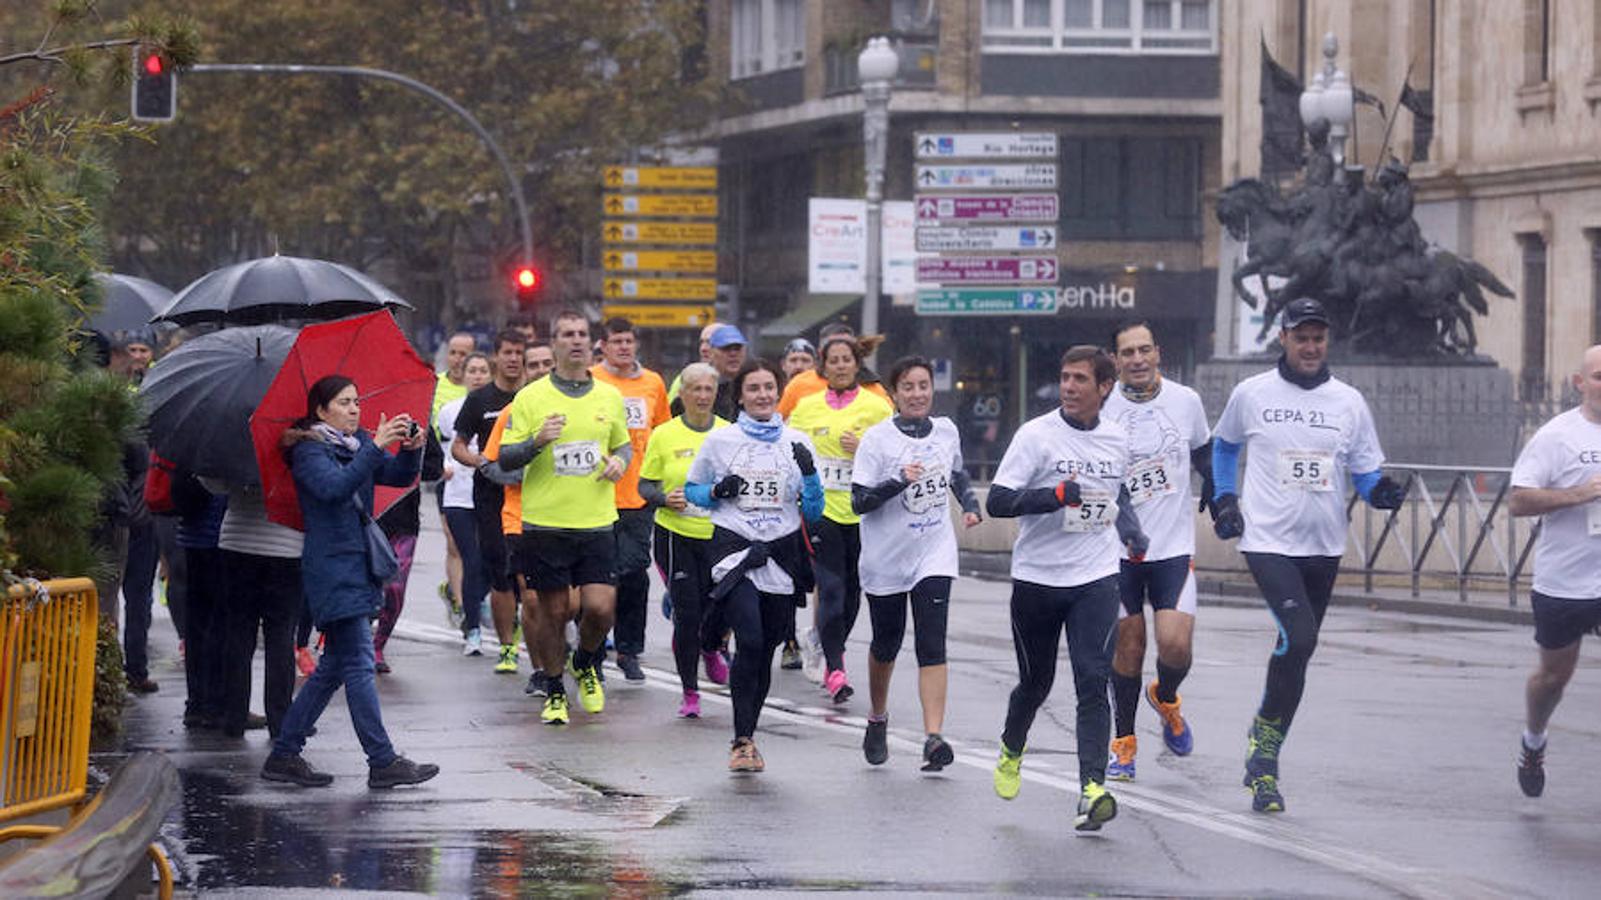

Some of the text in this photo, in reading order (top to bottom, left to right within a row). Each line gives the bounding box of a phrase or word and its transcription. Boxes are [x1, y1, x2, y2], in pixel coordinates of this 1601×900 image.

[813, 223, 864, 238] CreArt
[1262, 408, 1326, 424] CEPA 21
[560, 450, 595, 465] 110
[1056, 459, 1096, 474] CEPA
[1099, 461, 1114, 474] 21
[1292, 461, 1321, 479] 55
[911, 475, 948, 499] 254
[1130, 467, 1168, 493] 253
[740, 481, 779, 497] 255
[1080, 503, 1107, 520] 57
